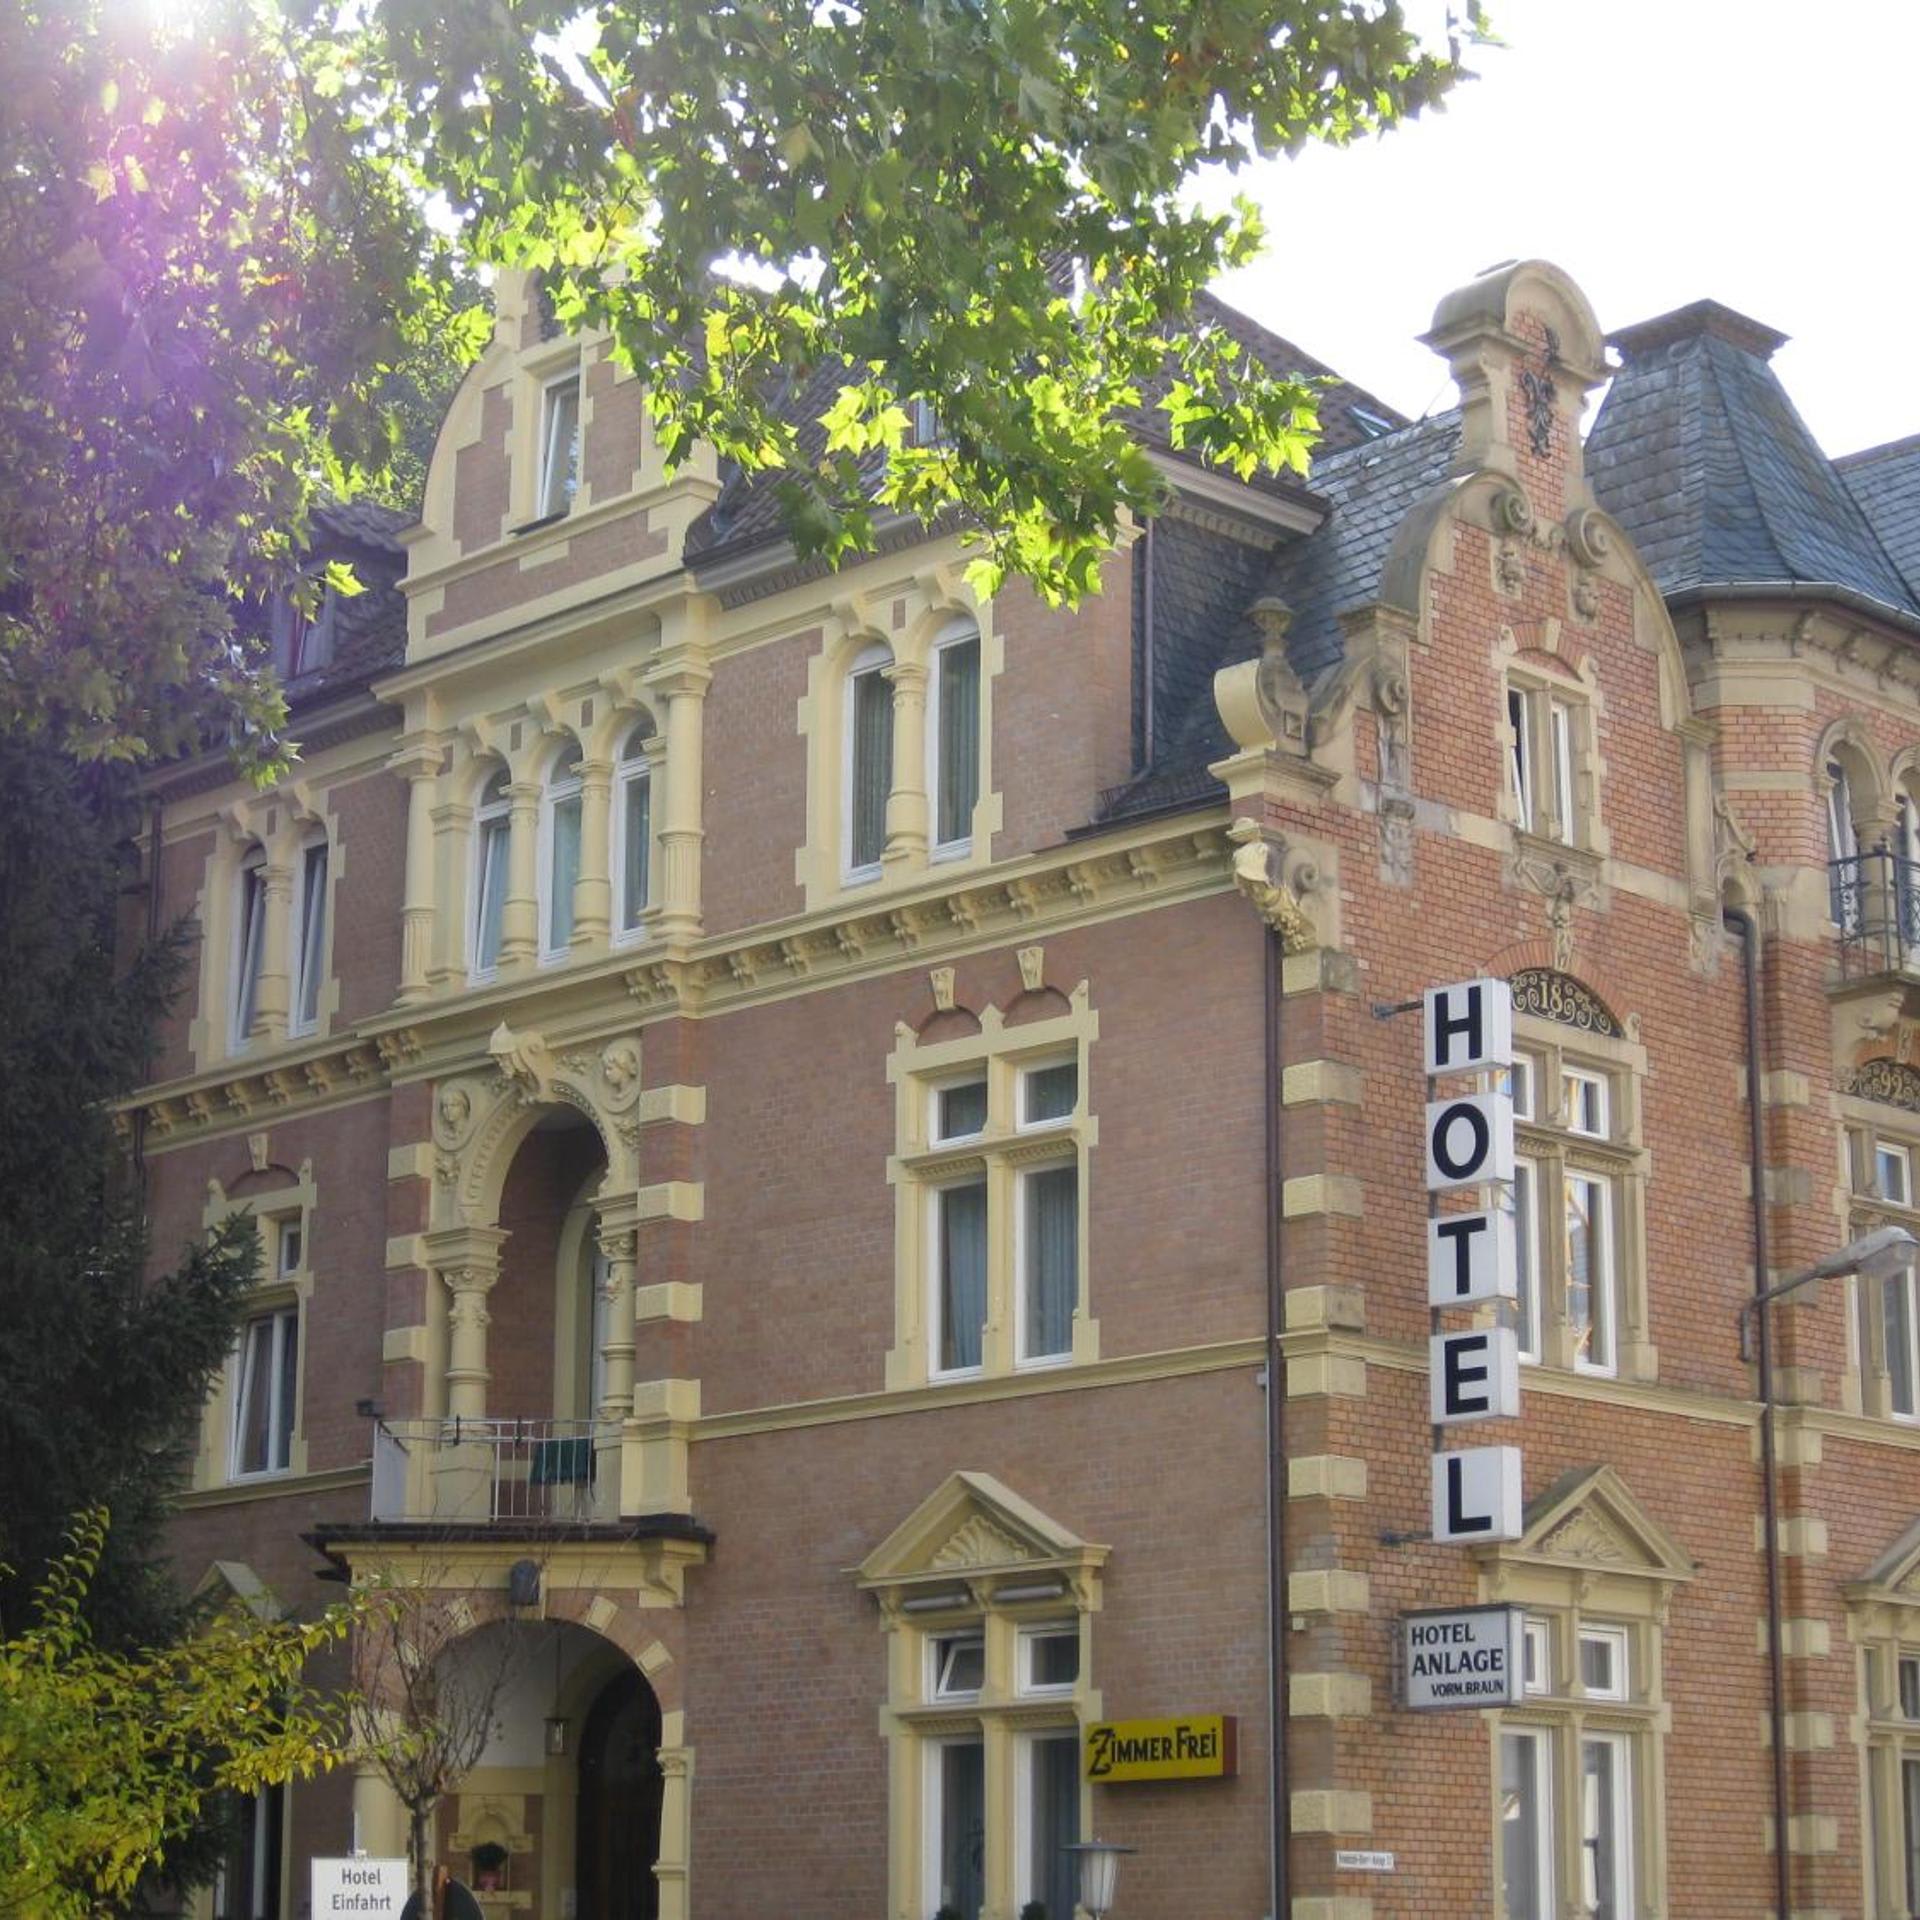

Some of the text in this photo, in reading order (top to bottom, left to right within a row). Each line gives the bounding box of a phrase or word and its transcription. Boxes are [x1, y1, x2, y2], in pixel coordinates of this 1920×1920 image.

[1540, 981, 1563, 1012] 18
[1432, 985, 1492, 1535] HOTEL
[1411, 1623, 1475, 1646] HOTEL
[1411, 1648, 1504, 1677] ANLAGE
[341, 1868, 381, 1885] Hotel
[332, 1893, 391, 1910] Einfahrt
